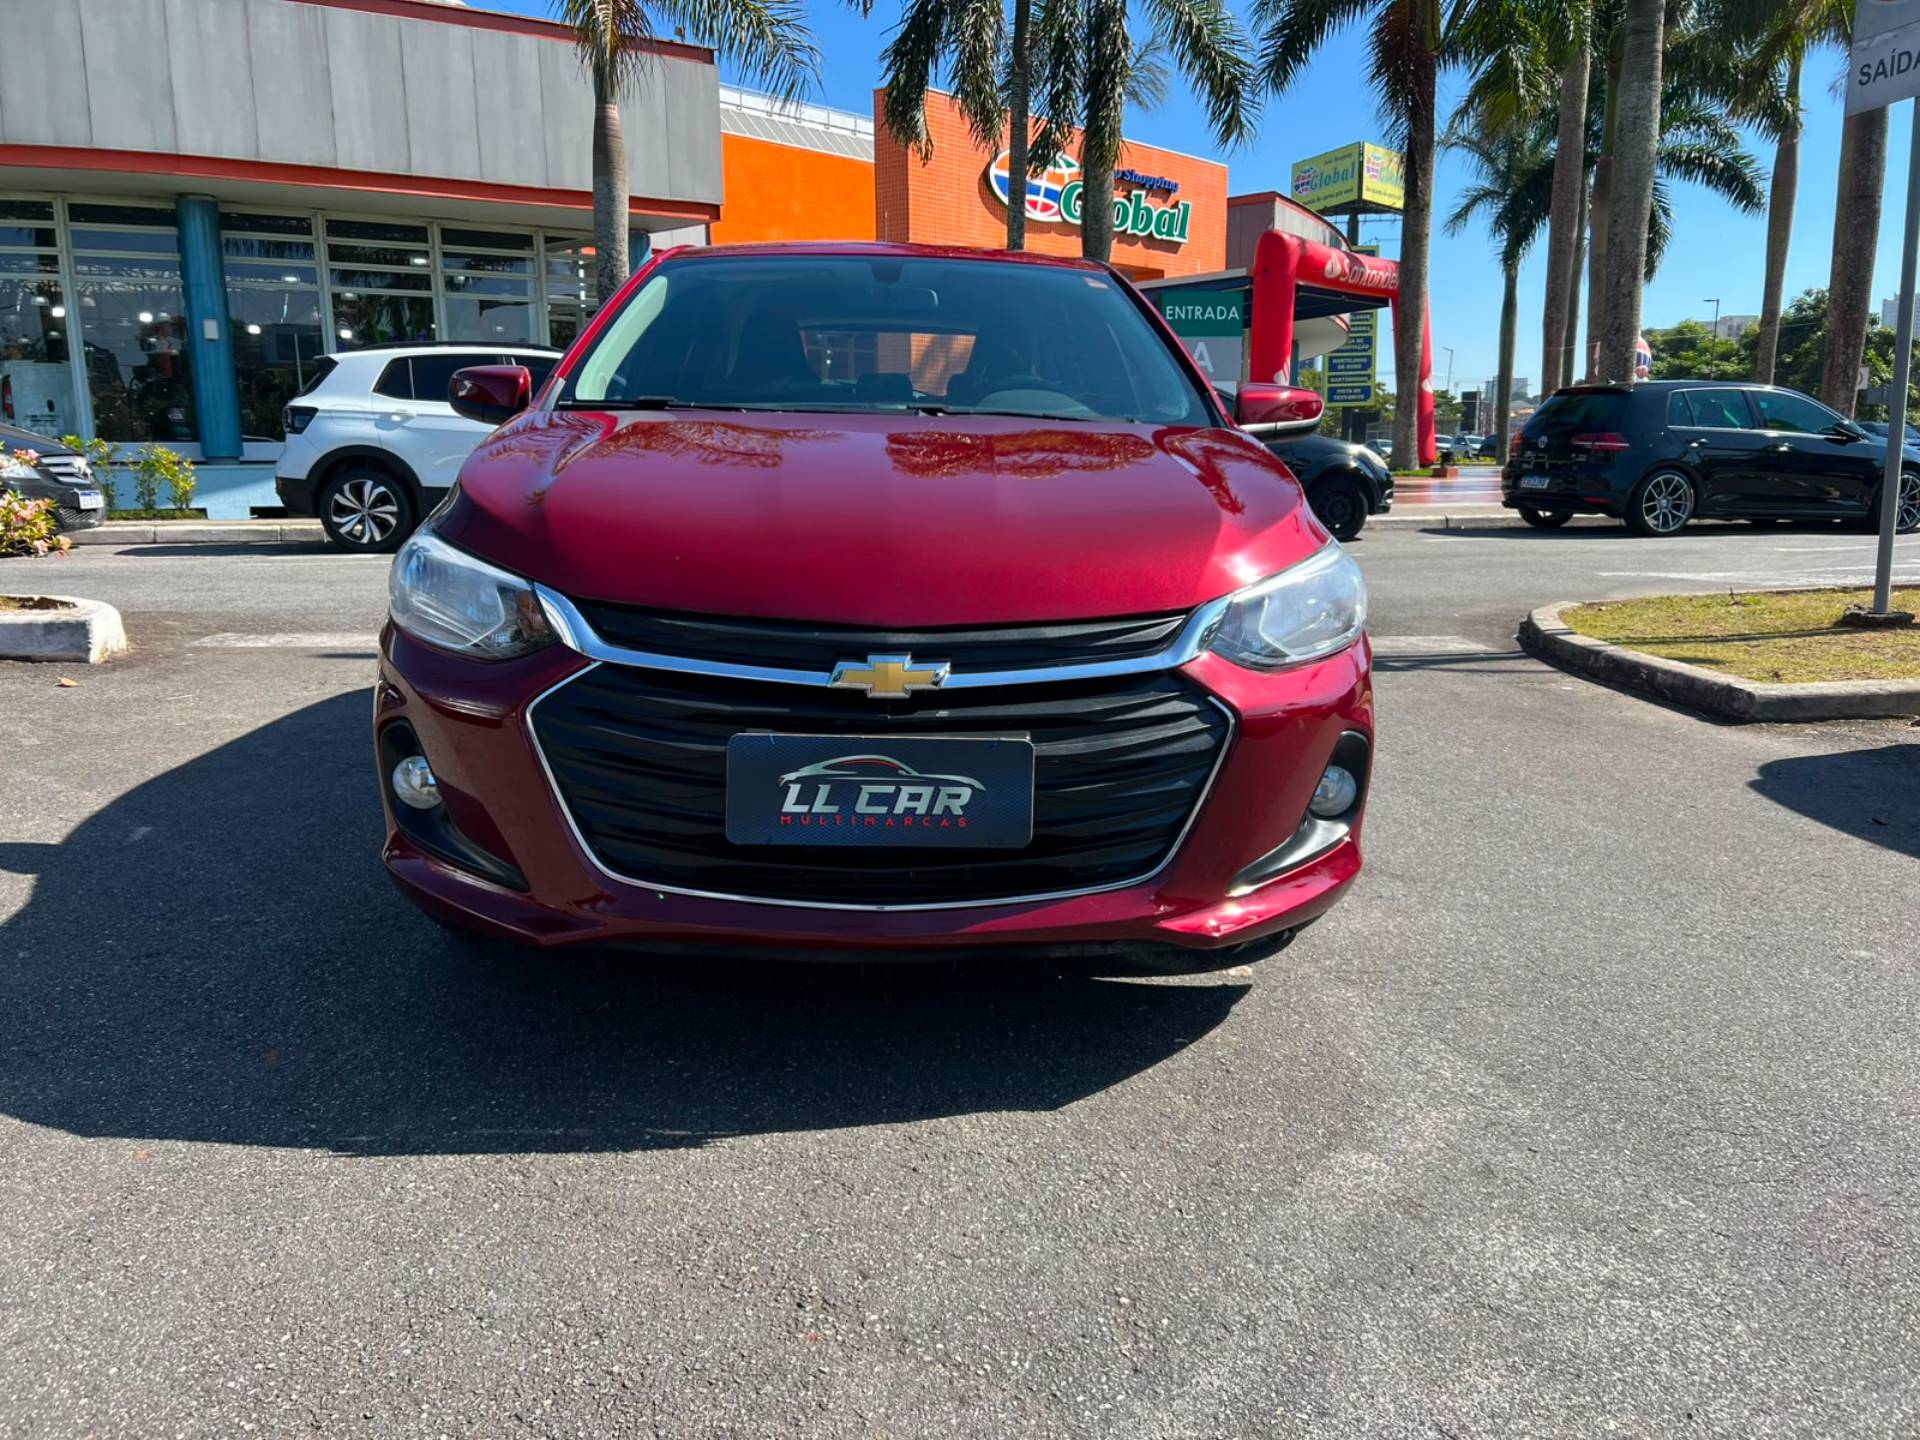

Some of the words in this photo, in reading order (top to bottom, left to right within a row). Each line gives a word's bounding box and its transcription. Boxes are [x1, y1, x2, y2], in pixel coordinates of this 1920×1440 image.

[1123, 169, 1179, 192] Shopping
[1309, 161, 1357, 191] Global
[1060, 179, 1191, 243] Gobal
[1165, 305, 1240, 320] ENTRADA
[1193, 341, 1215, 373] A
[781, 783, 839, 813] LL
[855, 784, 972, 815] CAR
[780, 815, 968, 827] MULTIMARCAS
